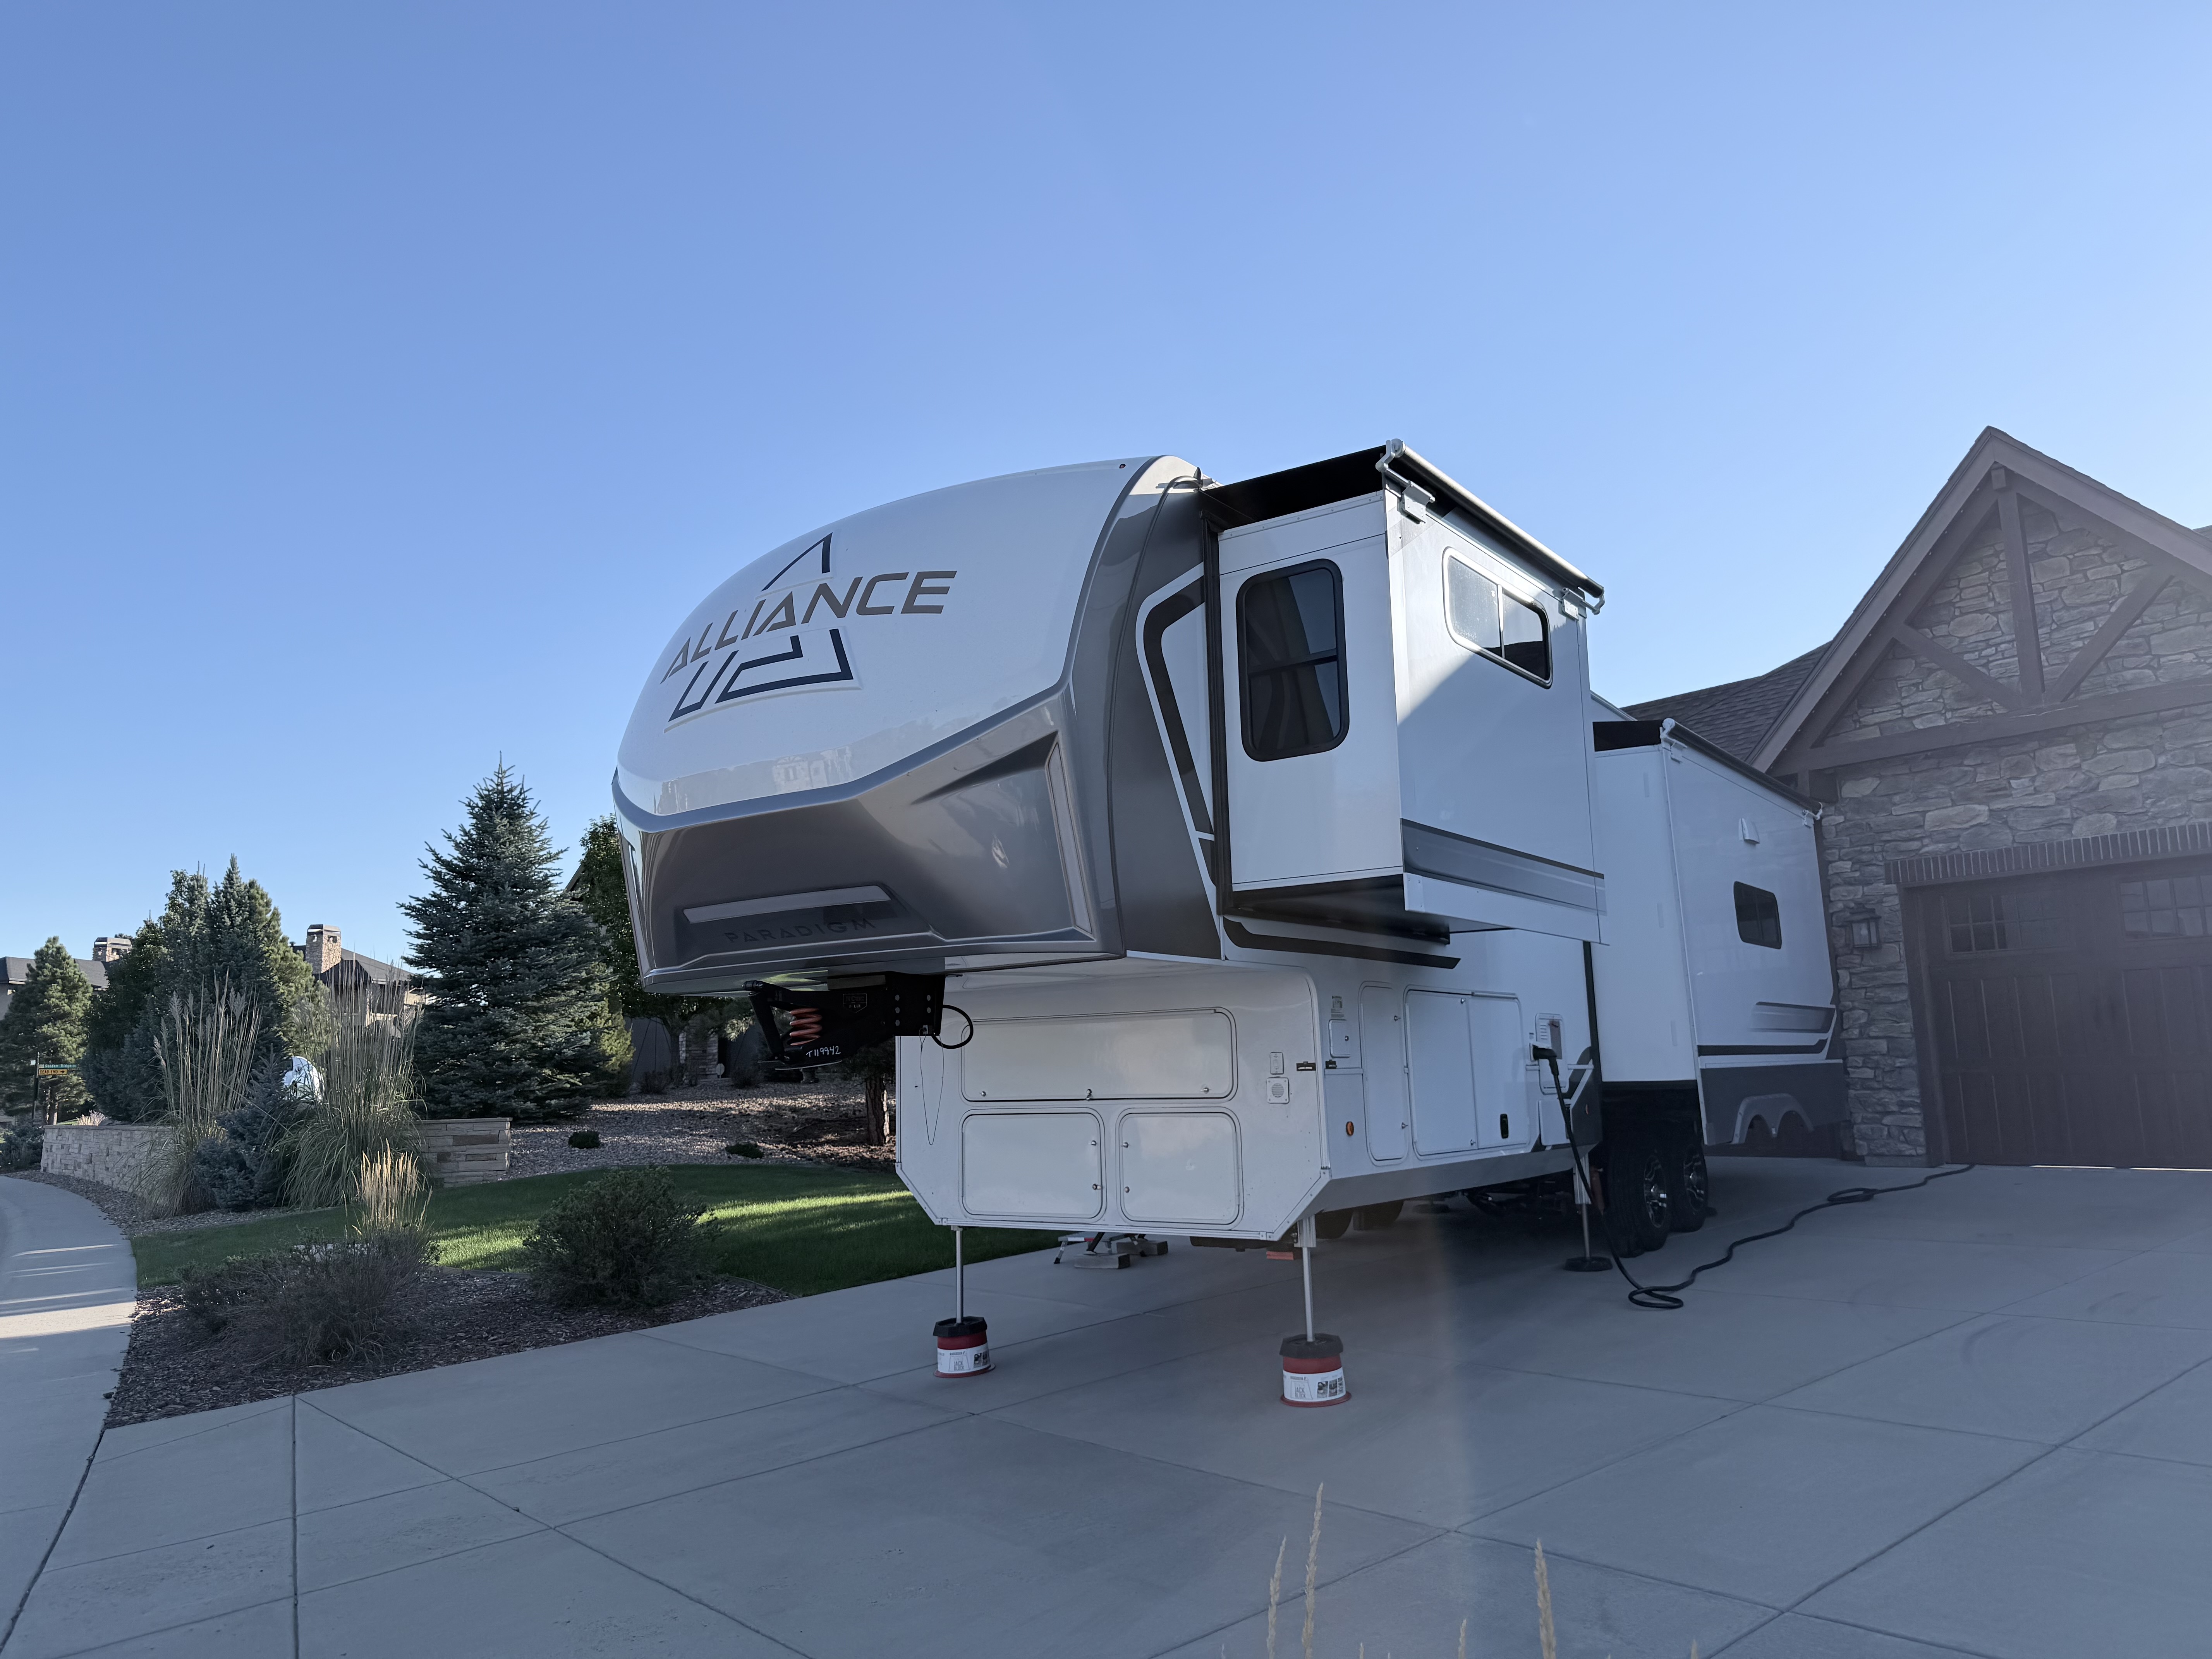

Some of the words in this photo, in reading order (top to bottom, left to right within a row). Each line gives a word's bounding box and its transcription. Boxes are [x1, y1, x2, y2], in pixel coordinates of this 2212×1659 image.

[660, 570, 957, 684] ALLIANCE
[724, 917, 876, 943] PARADIGM
[806, 1046, 841, 1058] T119942
